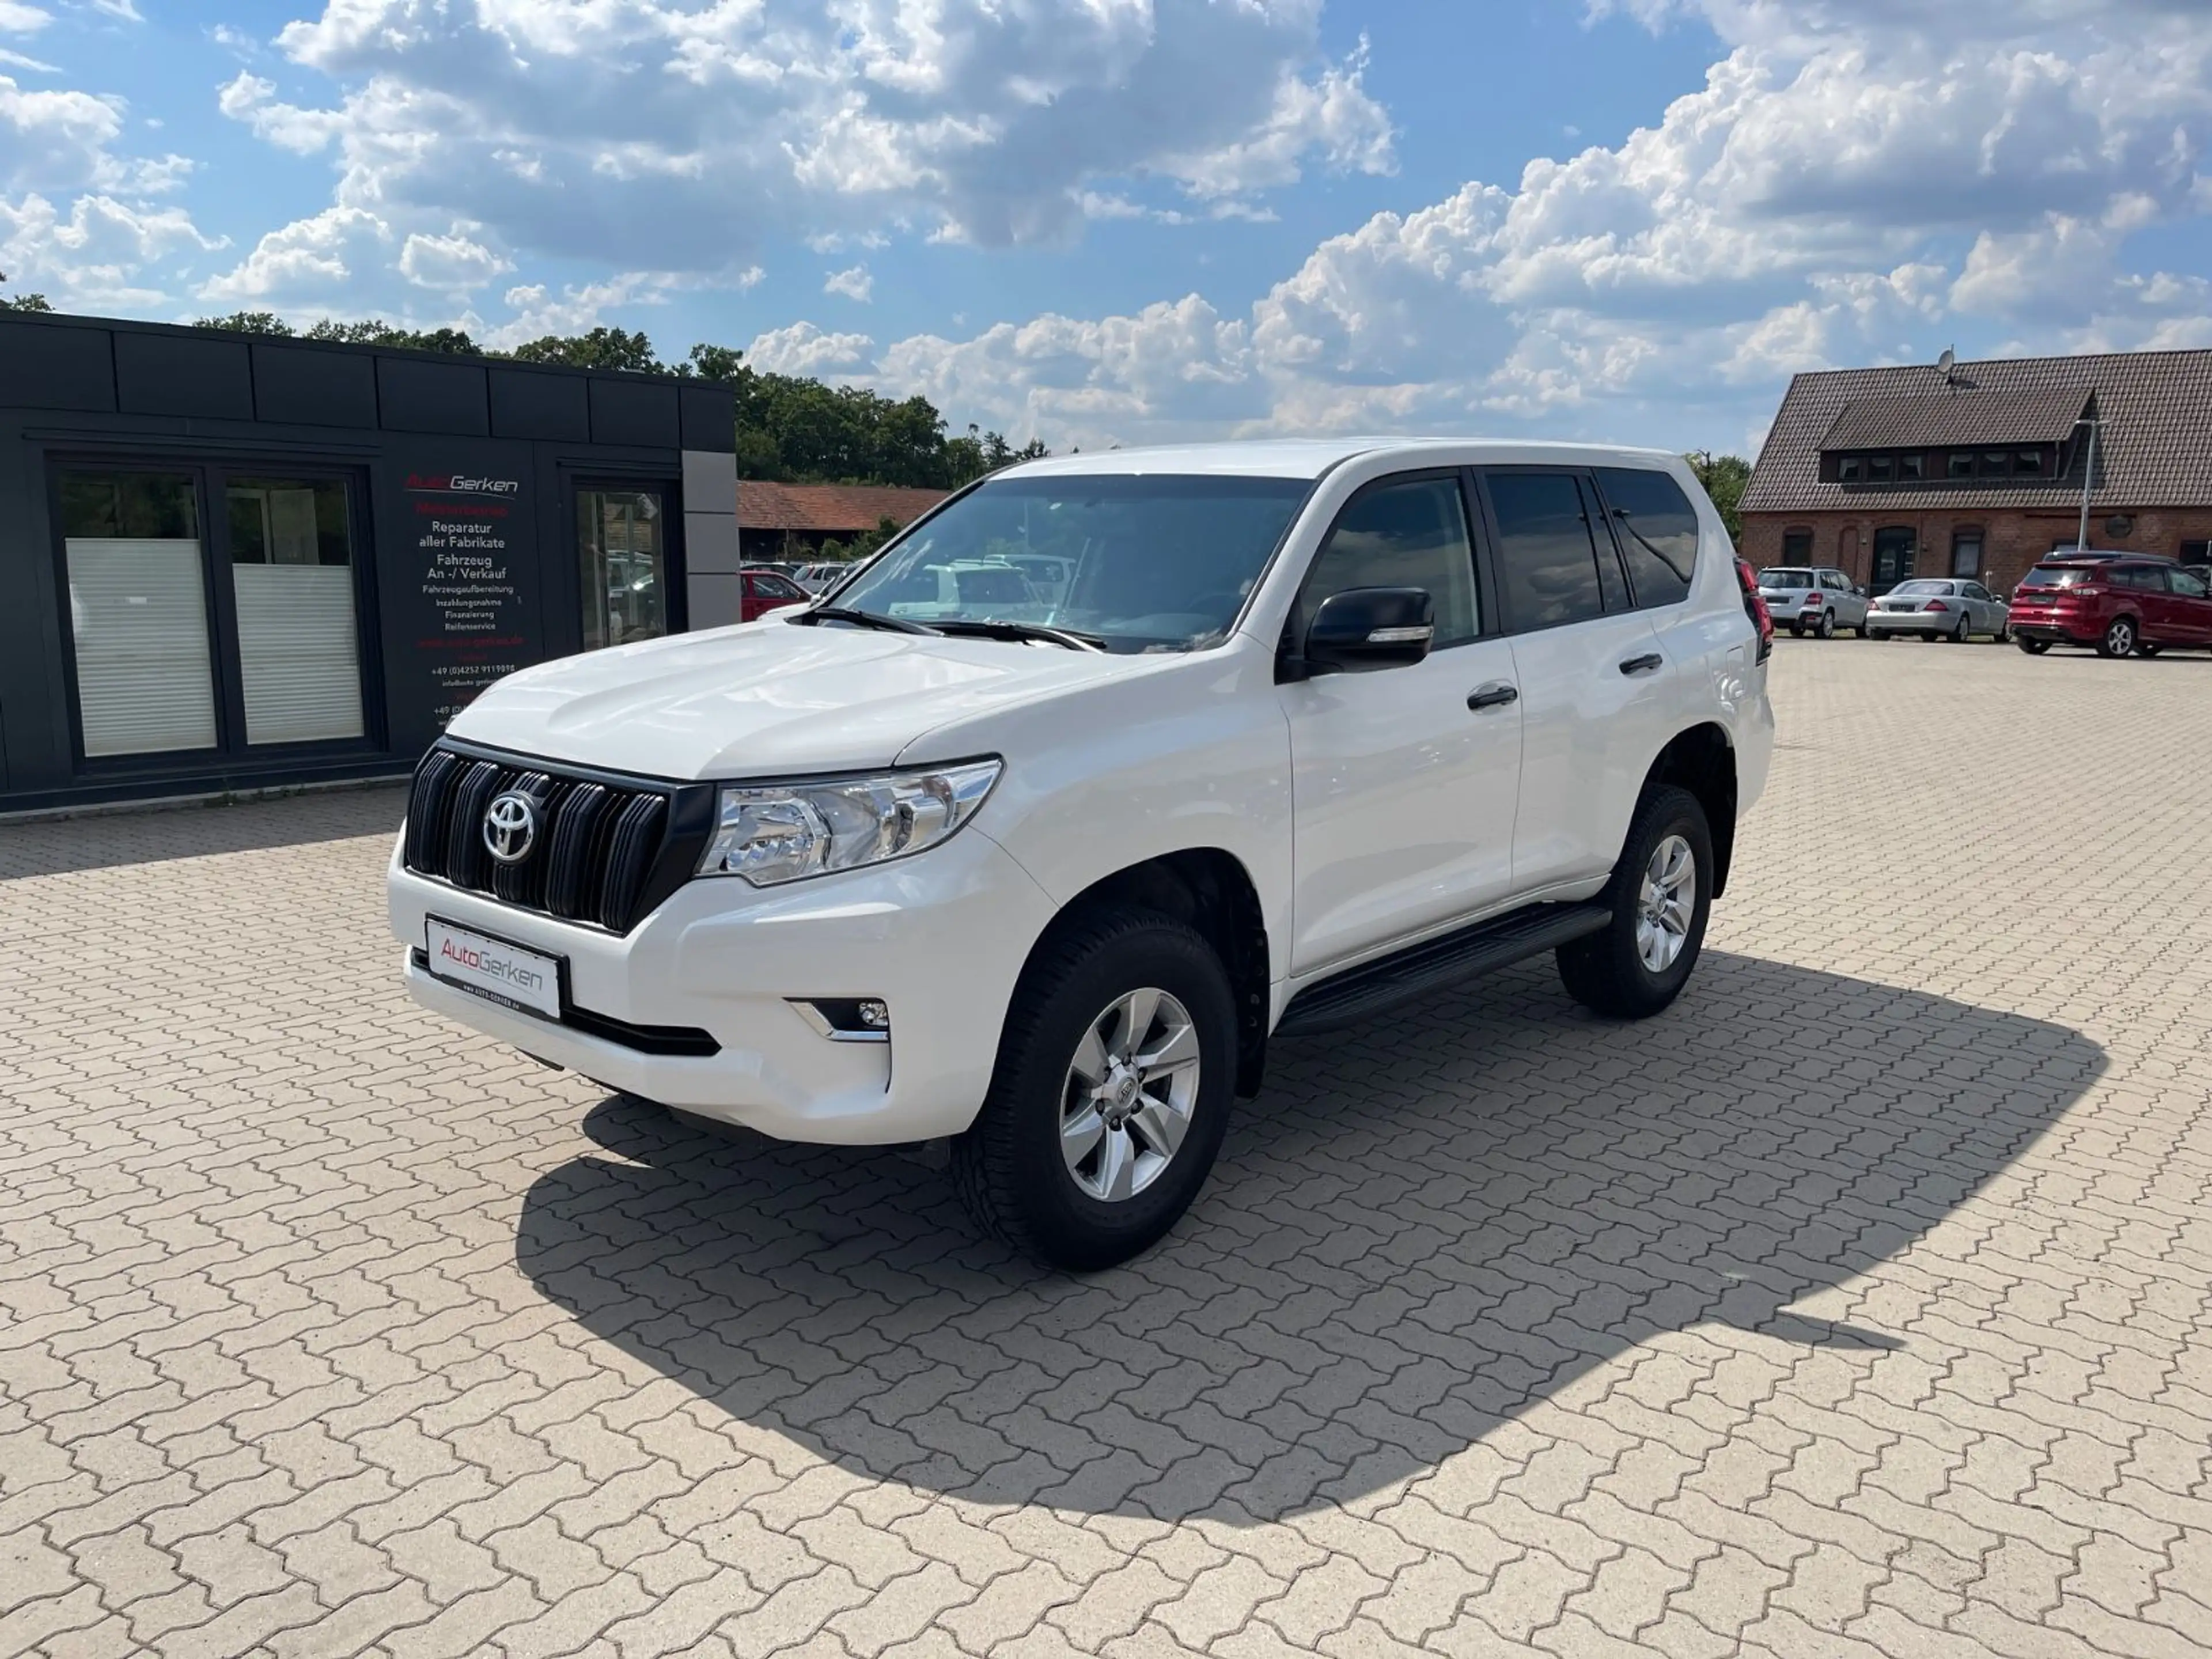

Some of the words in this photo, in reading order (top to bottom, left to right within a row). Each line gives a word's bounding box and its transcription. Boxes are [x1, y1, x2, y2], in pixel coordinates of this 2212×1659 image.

[432, 521, 492, 535] Reparatur
[419, 536, 446, 547] aller
[449, 536, 506, 548] Fabrikate
[437, 554, 493, 568] Fahrzeug
[427, 568, 445, 579] An
[461, 567, 507, 579] Verkauf
[422, 584, 514, 594] Fahrzeugaufbereitung
[435, 598, 502, 608] Inzahlungsnahme
[445, 611, 494, 619] Finanzierung
[445, 623, 496, 631] Reifenservice
[441, 938, 543, 991] AutoGerken
